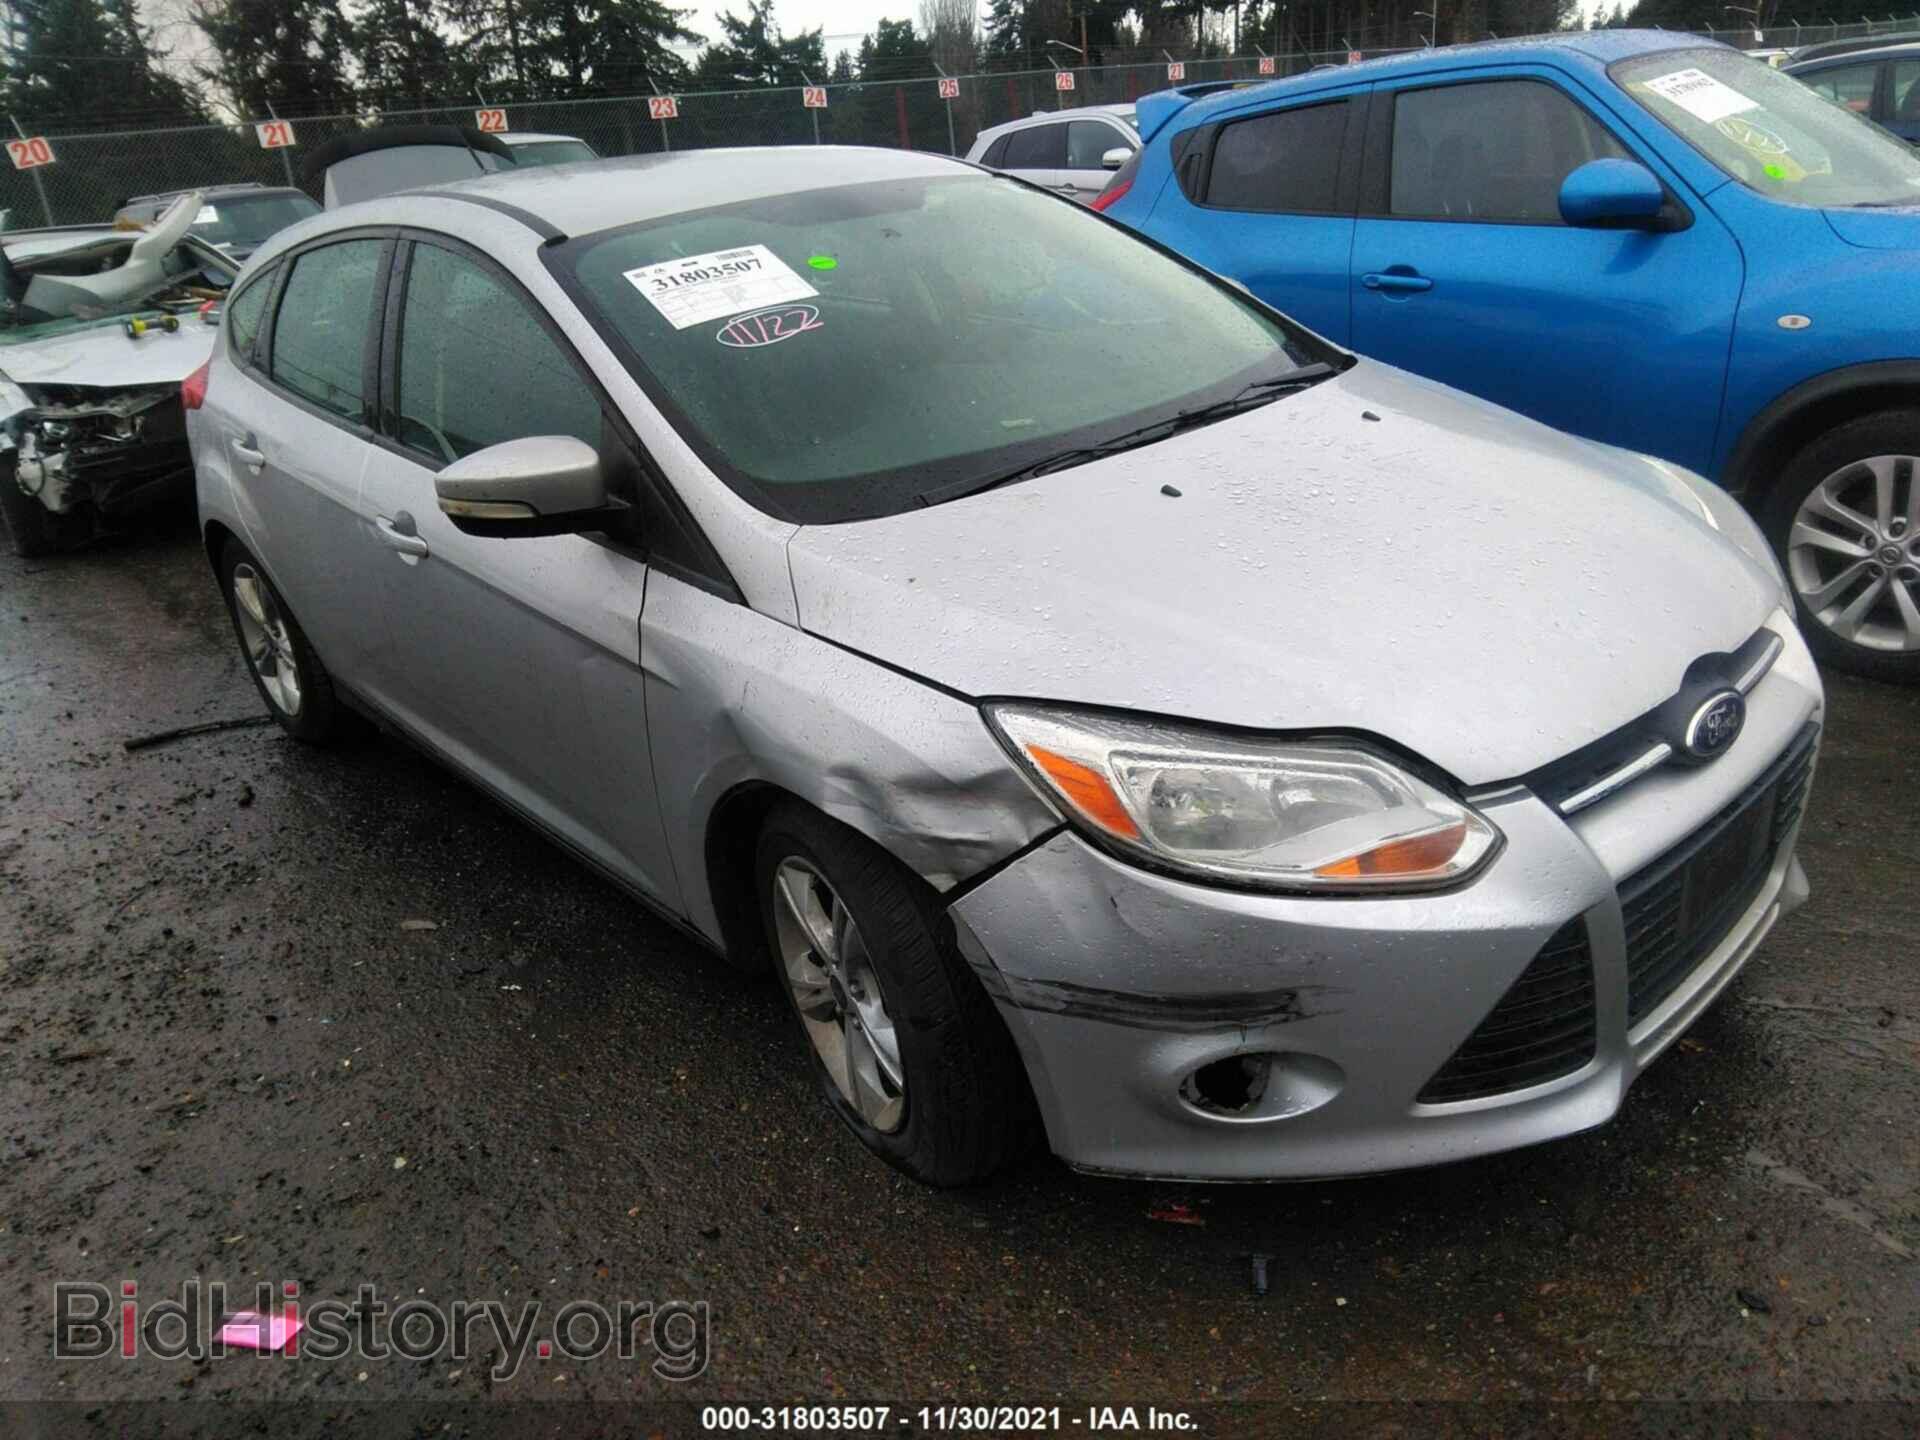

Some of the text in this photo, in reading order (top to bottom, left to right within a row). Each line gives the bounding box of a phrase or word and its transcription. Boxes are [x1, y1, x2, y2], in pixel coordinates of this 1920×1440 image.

[1057, 73, 1073, 89] 26
[1170, 64, 1182, 79] 27
[805, 88, 826, 106] 24
[940, 79, 958, 96] 25
[651, 97, 675, 117] 23
[479, 111, 504, 131] 22
[263, 124, 290, 146] 21
[11, 139, 51, 167] 20
[650, 257, 763, 291] 31803507
[726, 310, 824, 344] 11/22
